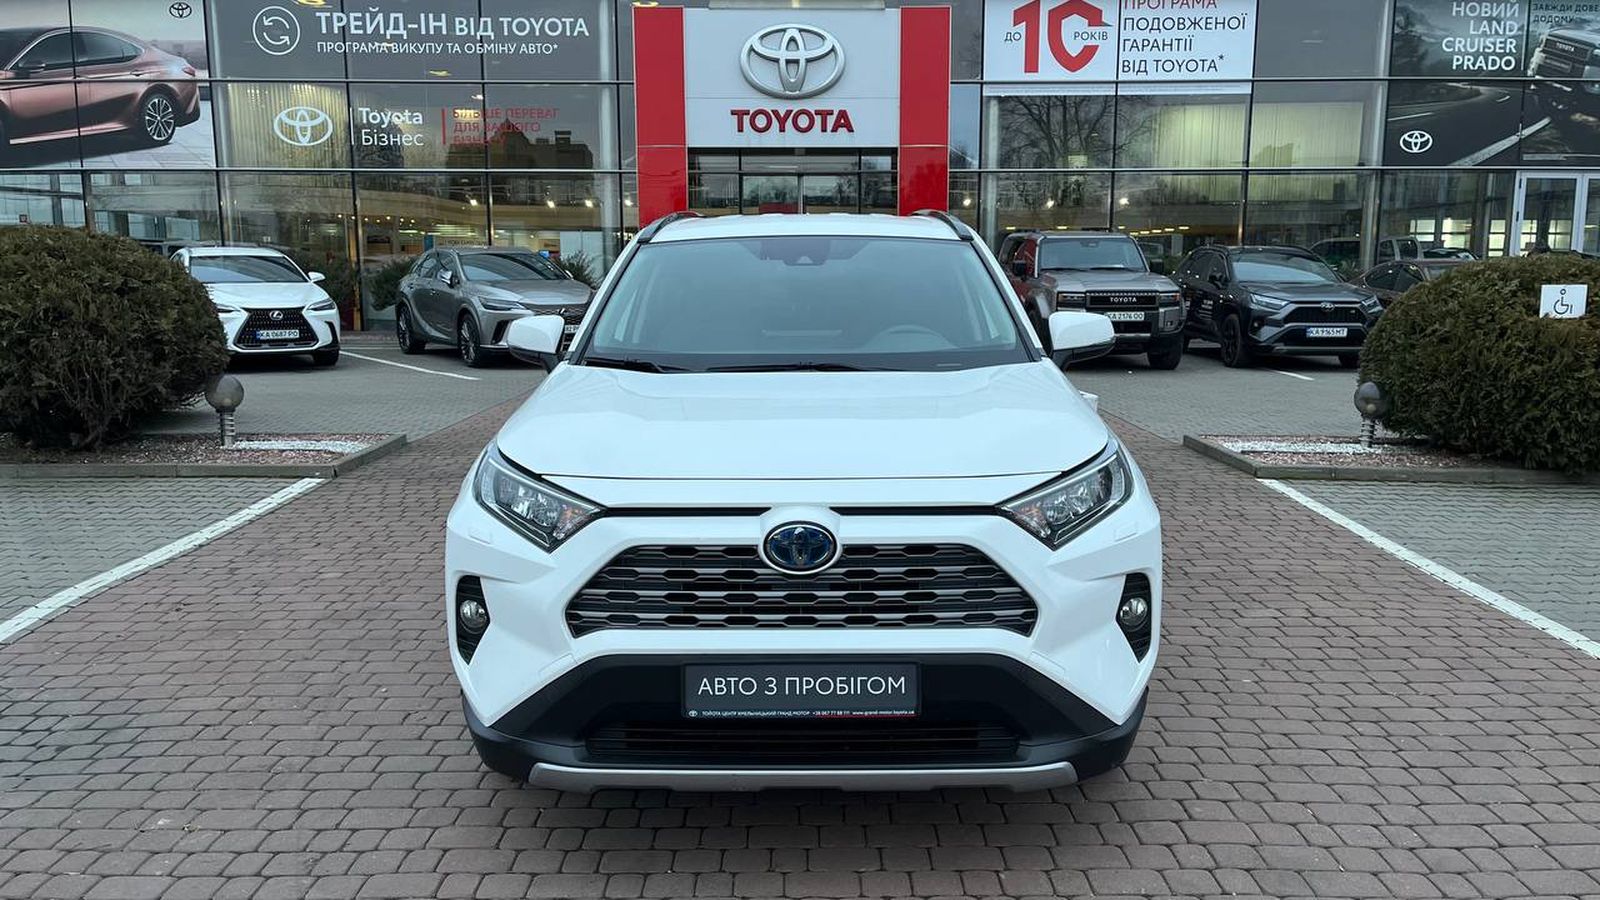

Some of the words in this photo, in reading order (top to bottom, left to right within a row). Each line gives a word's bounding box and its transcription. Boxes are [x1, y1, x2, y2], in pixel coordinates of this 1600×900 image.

[1124, 0, 1218, 10] ПРОГРАМА
[1451, 0, 1520, 18] НОВИЙ
[315, 7, 447, 39] ТРЕЙД-ІН
[455, 17, 494, 40] ВІД
[499, 17, 589, 36] TOYOTA
[1122, 13, 1248, 33] ПОДОВЖЕНОЇ
[1469, 20, 1518, 35] LAND
[1004, 31, 1022, 42] ДО
[1073, 31, 1108, 41] РОКІВ
[1122, 34, 1195, 52] ГАРАНТІЇ
[316, 41, 388, 53] ПРОГРАМА
[391, 42, 443, 54] ВИКУПУ
[446, 42, 461, 54] ТА
[464, 42, 517, 54] ОБМІНУ
[1442, 37, 1517, 53] CRUISER
[1121, 59, 1148, 75] ВІД
[1452, 55, 1516, 71] PRADO
[358, 107, 423, 129] Toyota
[731, 109, 854, 133] TOYOTA
[453, 121, 480, 132] ДЛЯ
[361, 129, 424, 146] Бізнес
[698, 677, 757, 695] АВТО
[764, 677, 777, 695] З
[785, 676, 905, 695] ПРОБІГОМ
